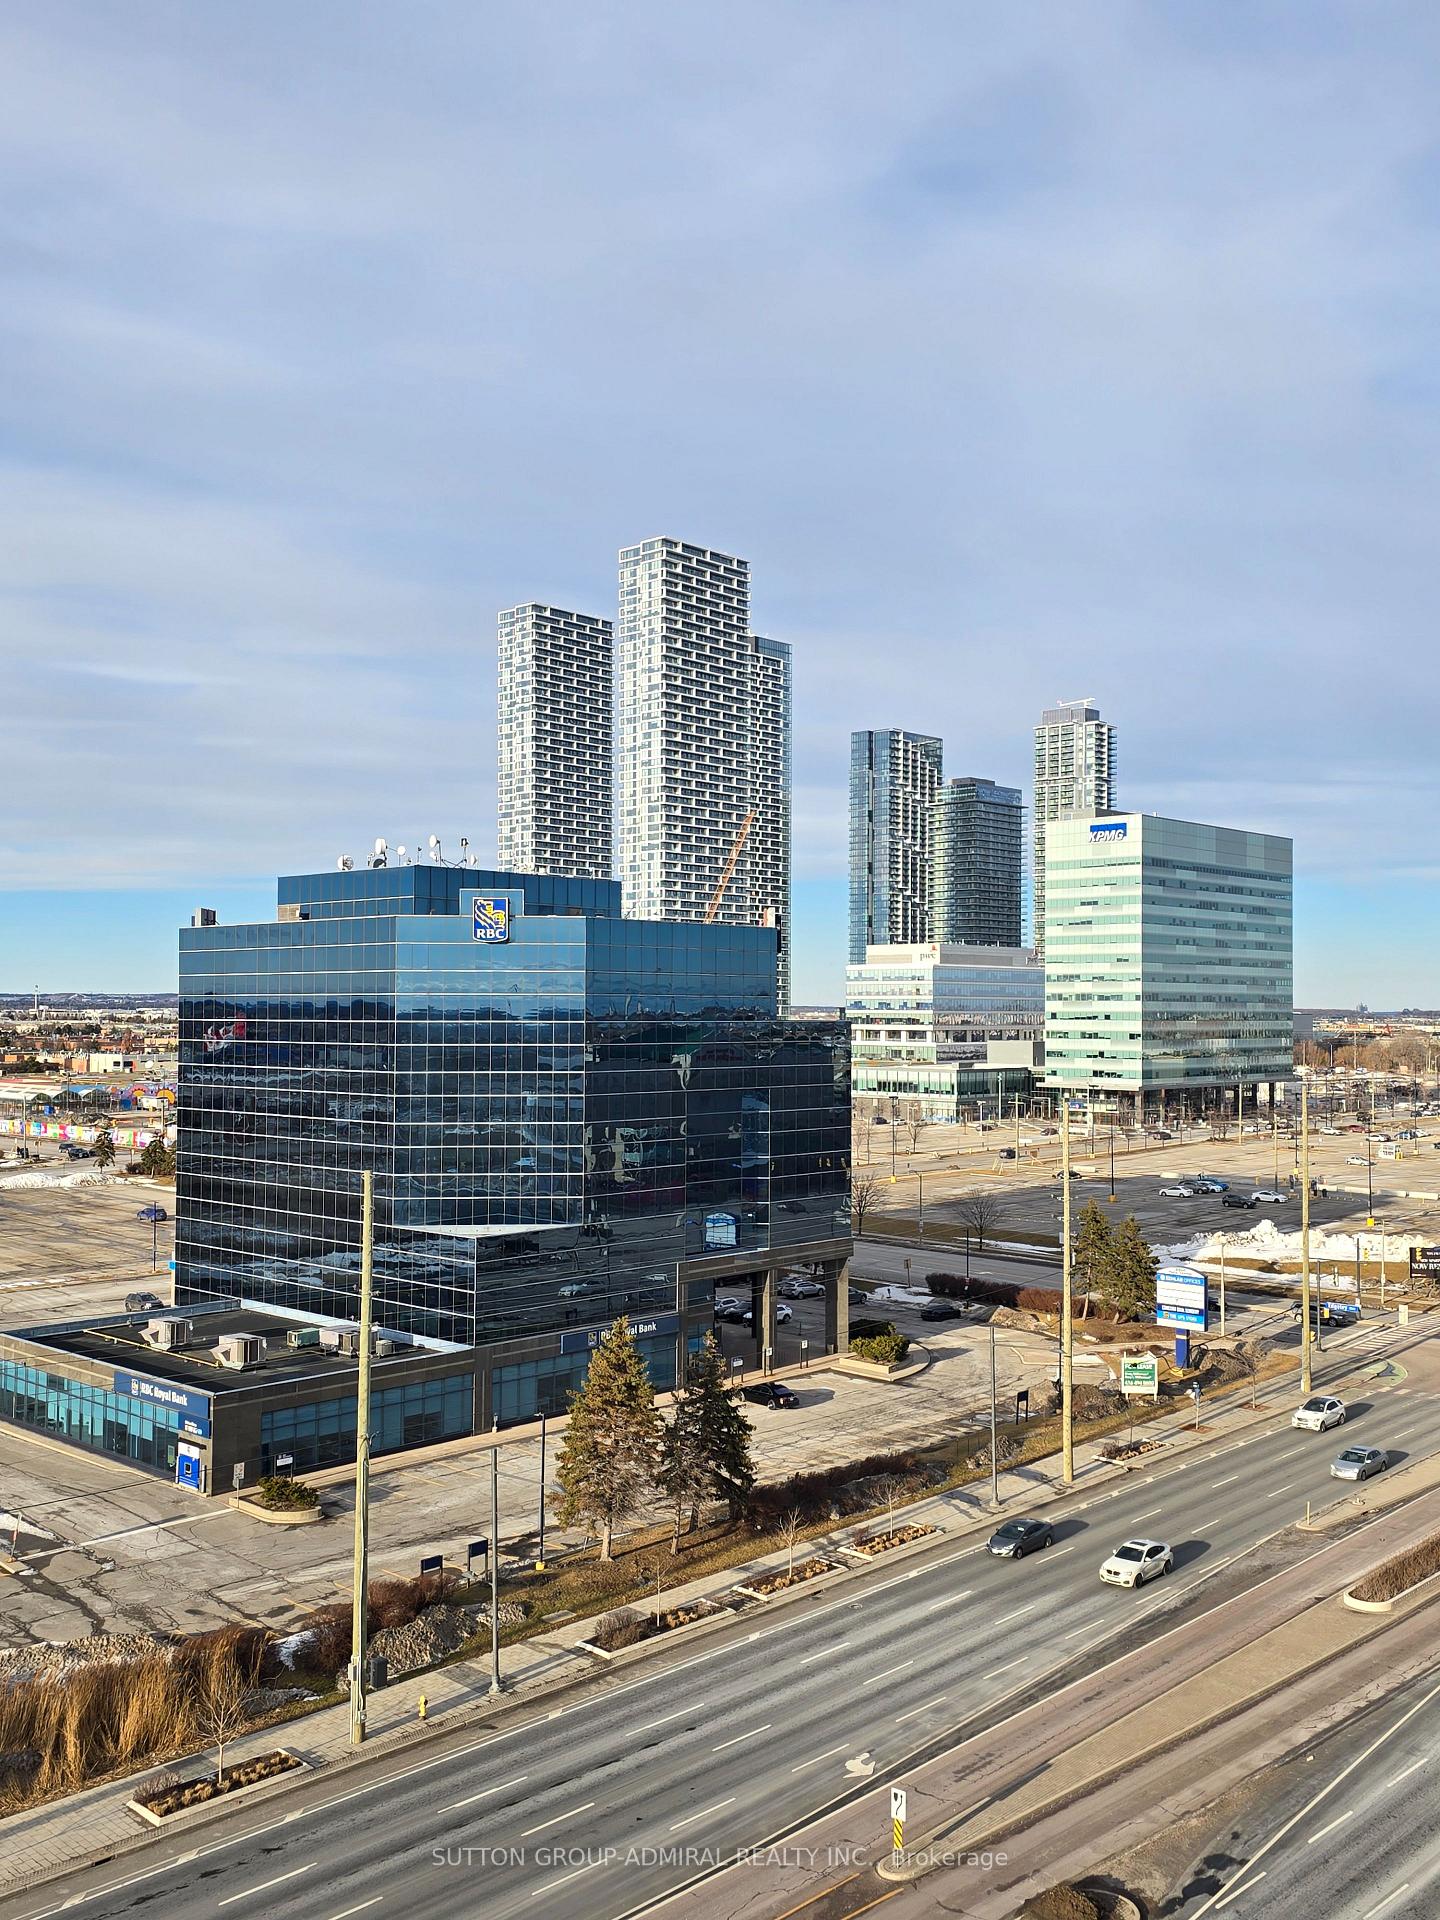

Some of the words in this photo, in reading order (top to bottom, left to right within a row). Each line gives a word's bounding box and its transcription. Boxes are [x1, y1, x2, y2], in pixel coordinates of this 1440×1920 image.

[1089, 829, 1124, 842] KPMG
[476, 928, 505, 939] RBC
[1411, 1262, 1428, 1270] NOW
[638, 1321, 657, 1333] Bank
[141, 1382, 154, 1397] RBC
[153, 1386, 171, 1402] Royal
[171, 1391, 188, 1406] Bank
